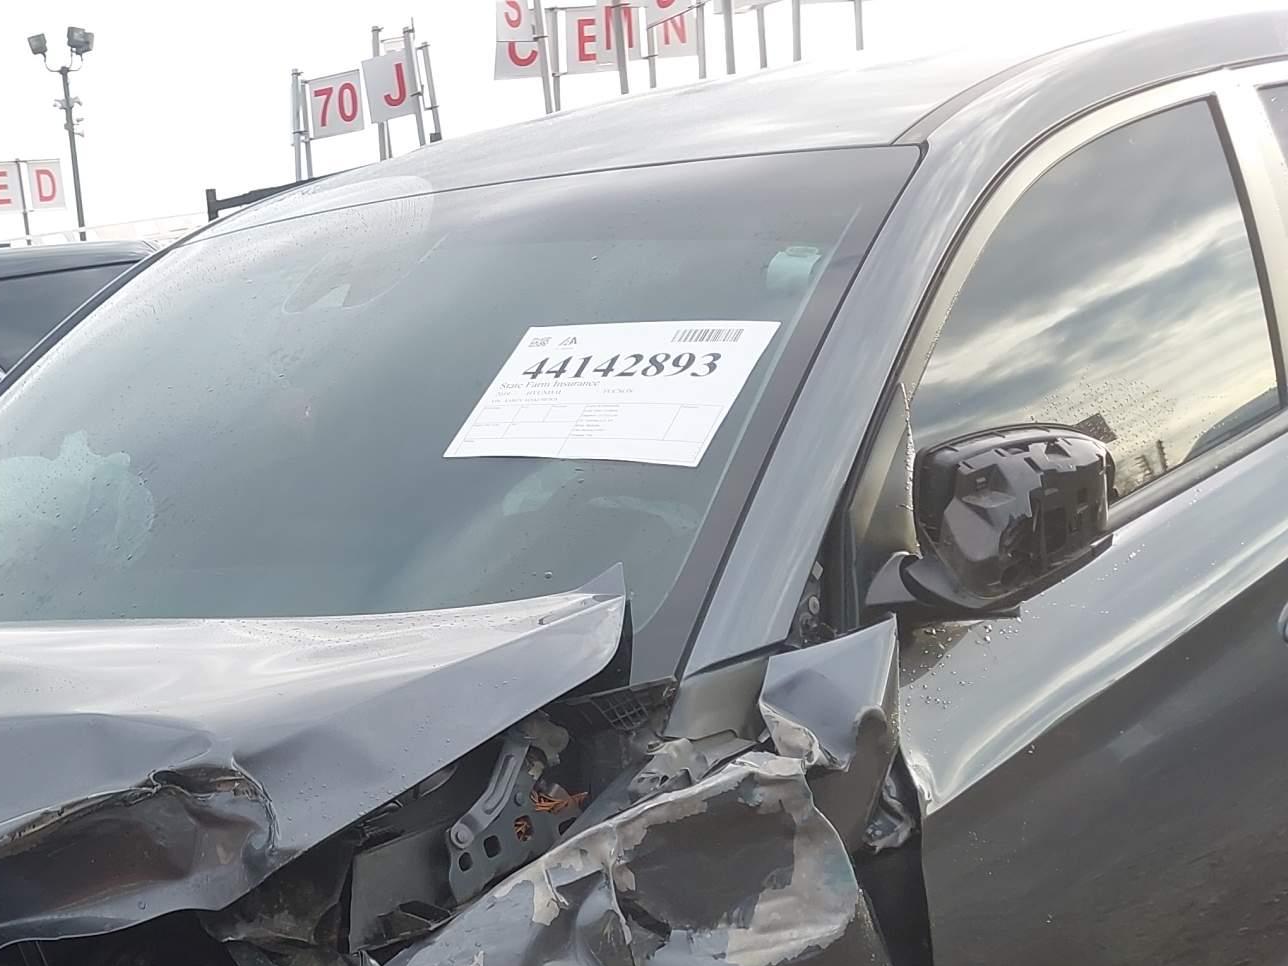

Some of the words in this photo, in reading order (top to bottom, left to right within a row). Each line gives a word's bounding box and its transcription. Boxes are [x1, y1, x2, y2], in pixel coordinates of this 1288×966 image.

[576, 18, 597, 62] E
[313, 81, 359, 128] 70
[383, 62, 408, 107] J
[35, 168, 58, 203] D
[522, 352, 722, 380] 44142893
